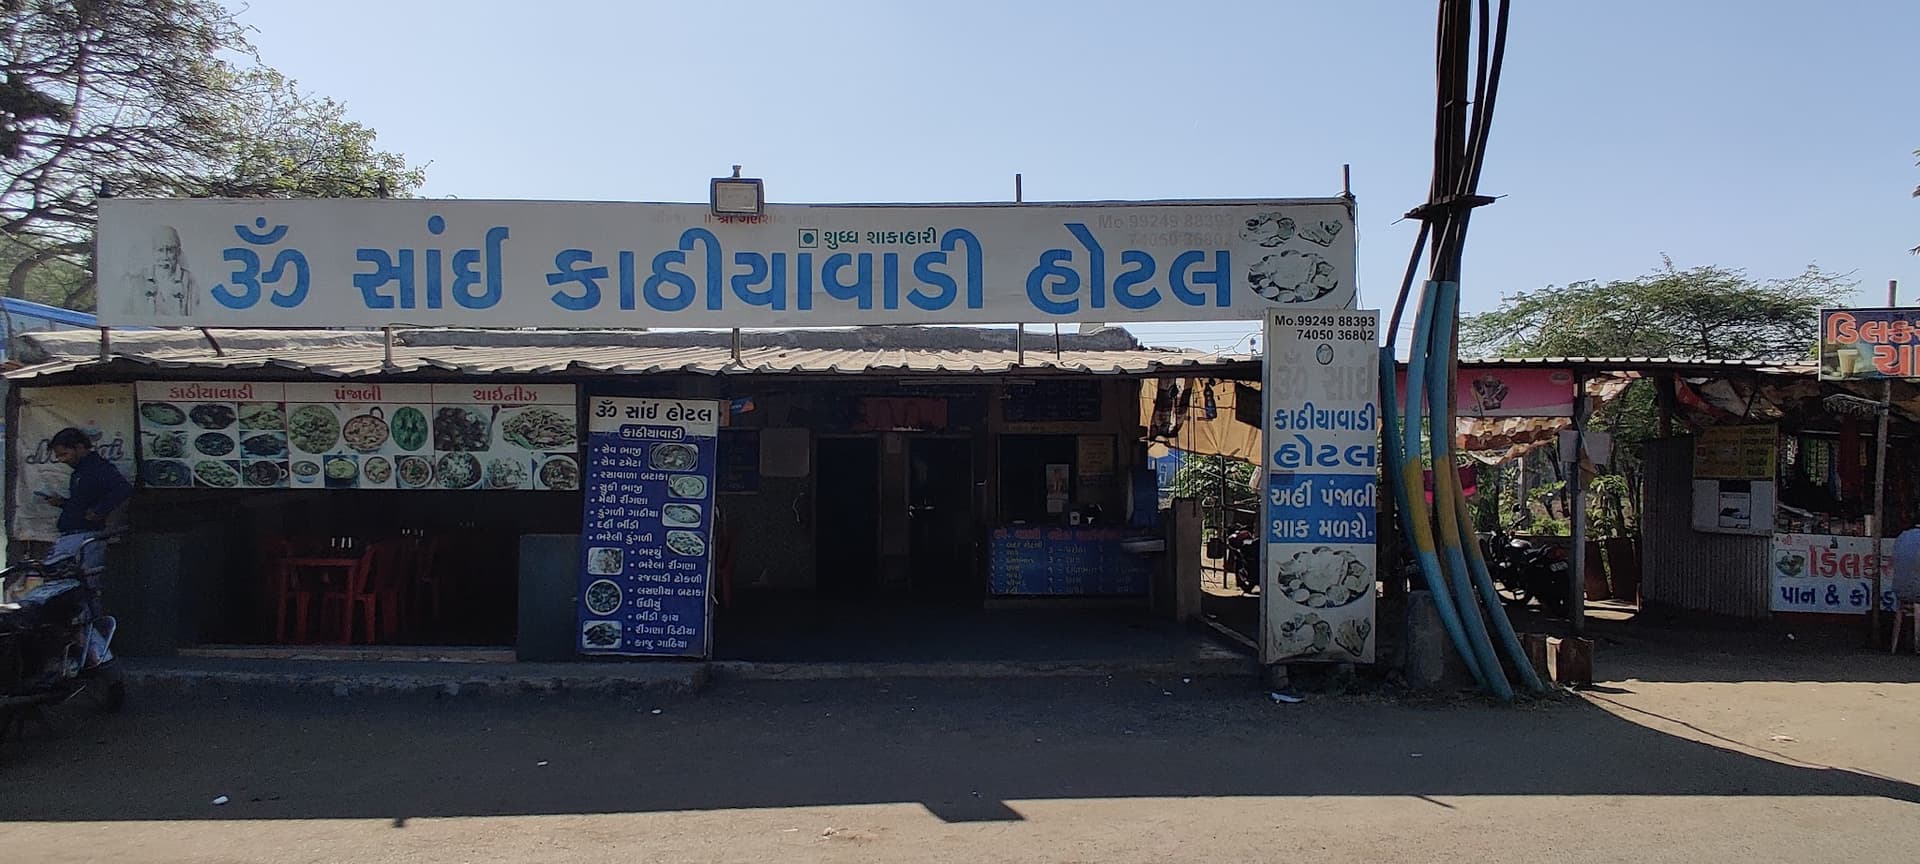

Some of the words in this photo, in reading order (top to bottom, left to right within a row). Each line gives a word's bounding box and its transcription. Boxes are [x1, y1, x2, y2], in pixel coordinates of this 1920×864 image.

[866, 226, 938, 245] શાકાહારી
[352, 214, 510, 310] સાંઈ
[546, 226, 983, 312] કાઠીયાવાડી
[1026, 223, 1232, 315] હોટલ
[1274, 315, 1335, 327] Mo.99249
[1338, 315, 1376, 327] 88393
[1296, 329, 1334, 341] 74050
[1337, 329, 1375, 341] 36802
[168, 382, 254, 399] કાઠીયાવાડી
[334, 384, 383, 401] પંજાબી
[666, 402, 712, 422] હોટલ
[1273, 401, 1376, 431] કાઠીયાવાડી
[622, 425, 683, 440] કાઠીયાવાડી
[601, 444, 616, 455] સેવ
[620, 447, 642, 456] ભાજી
[1273, 434, 1375, 469] હોટલ
[600, 456, 616, 467] સેવ
[619, 457, 642, 468] ટમેટા
[641, 473, 669, 481] બટાકા
[621, 485, 643, 494] ભાજી
[1321, 478, 1376, 508] પંજાબી
[628, 508, 659, 518] ગાઠીયા
[1271, 518, 1310, 538] શાક
[596, 532, 622, 542] ભરેલી
[625, 531, 653, 545] ડુંગળી
[637, 560, 664, 570] ભરેલા
[637, 574, 671, 583] રજવાડી
[636, 586, 674, 596] લસણીયા
[677, 588, 705, 597] બટાકા
[1780, 585, 1816, 604] પાન
[1824, 583, 1840, 605] &
[634, 639, 654, 650] કાજુ
[657, 638, 688, 649] ગાઠિયા
